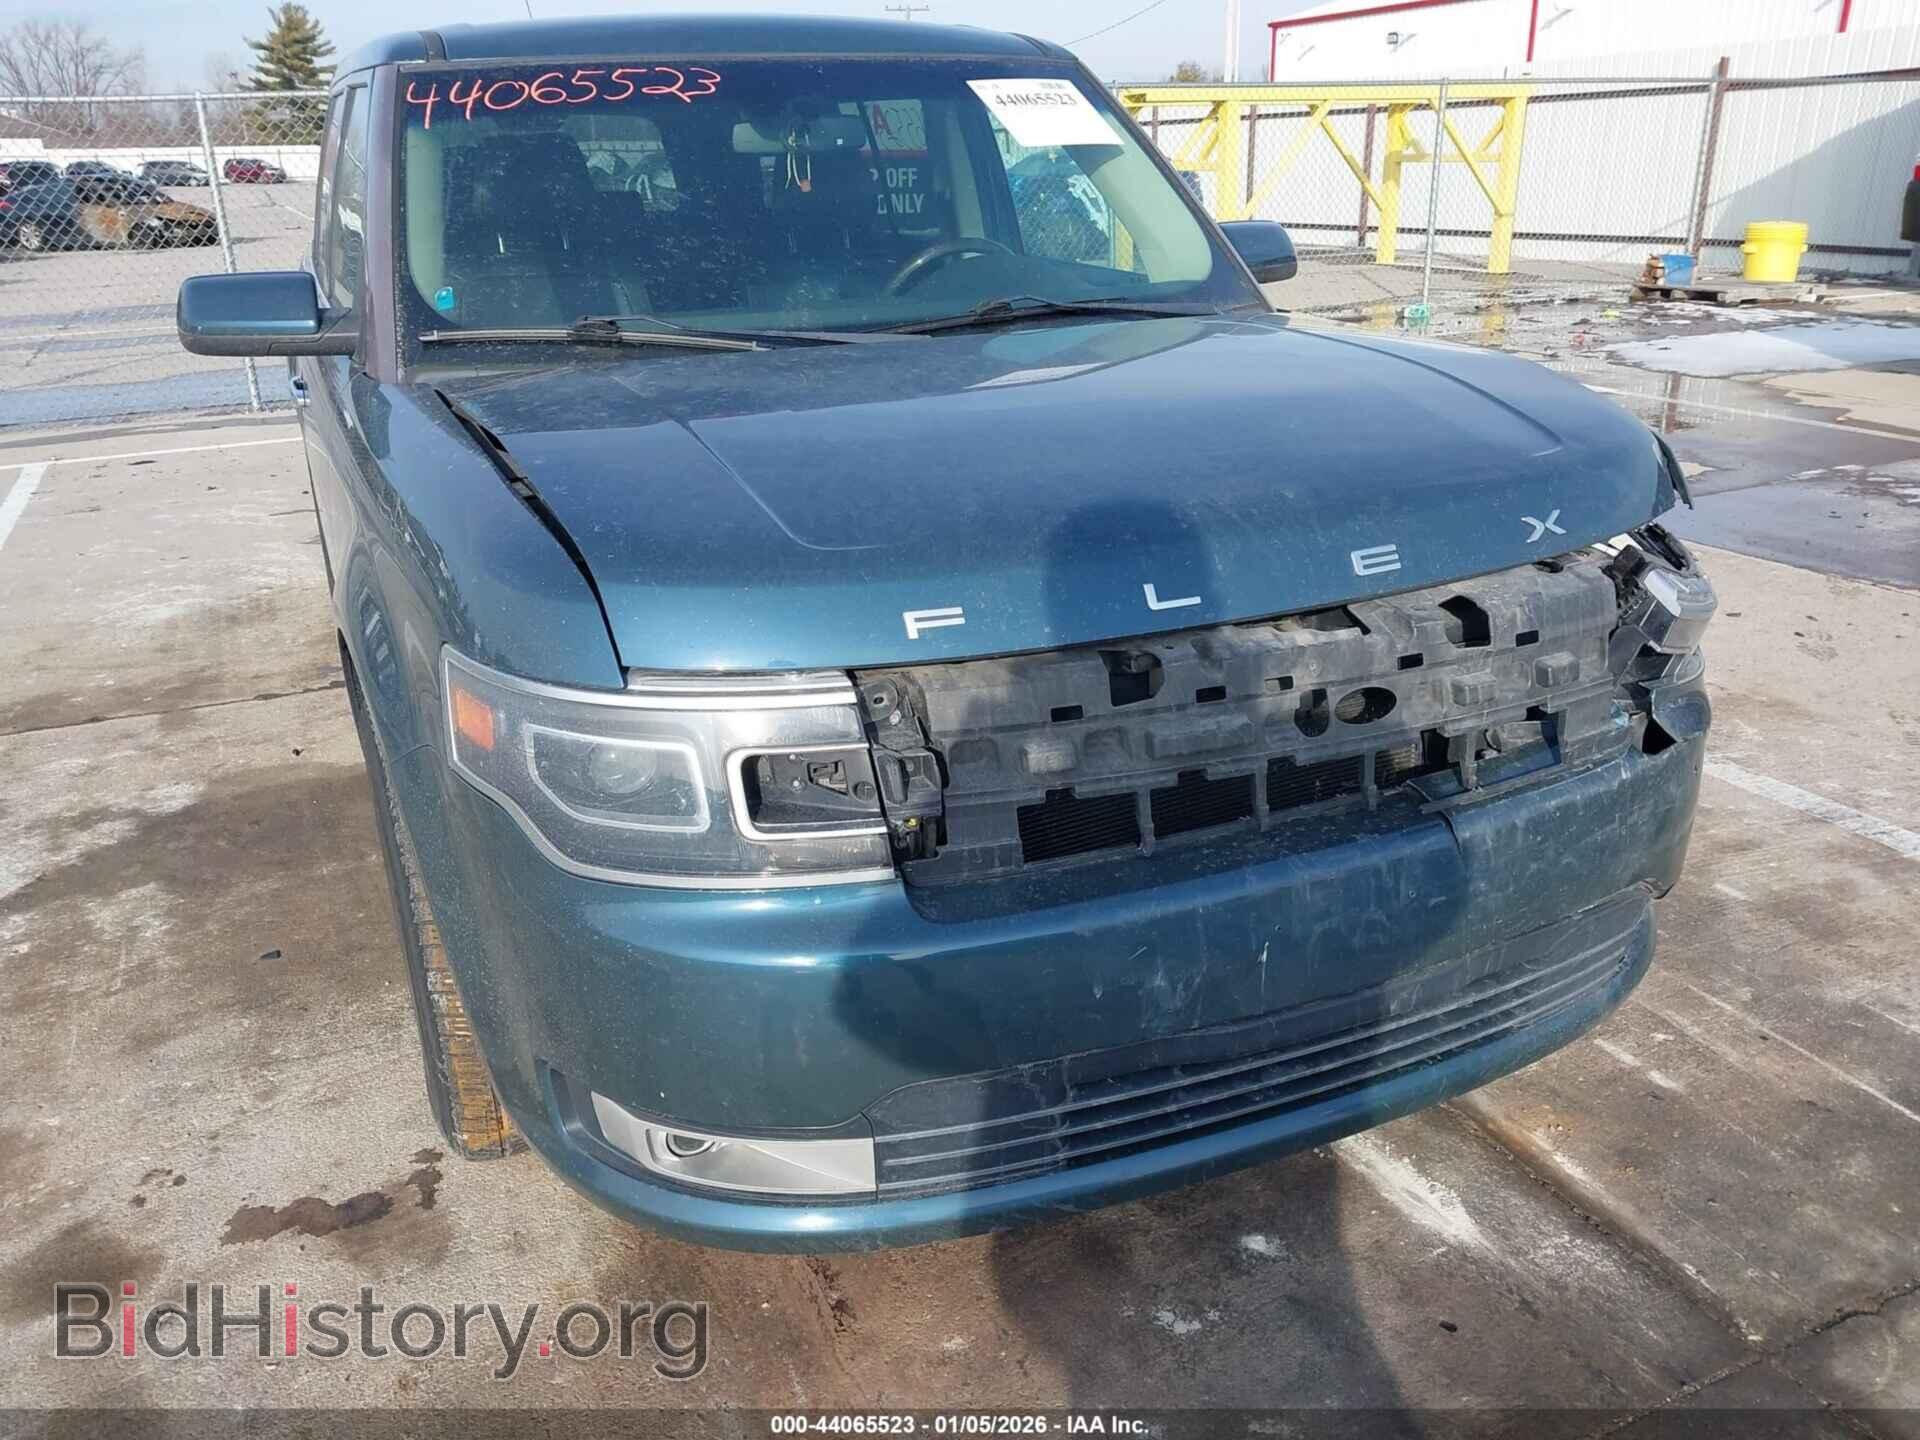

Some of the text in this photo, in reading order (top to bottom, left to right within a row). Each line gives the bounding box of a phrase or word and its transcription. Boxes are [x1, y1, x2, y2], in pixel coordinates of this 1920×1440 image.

[405, 67, 721, 129] 44065523
[994, 93, 1077, 106] 44065523
[885, 167, 918, 188] OFF
[877, 193, 924, 214] ONLY
